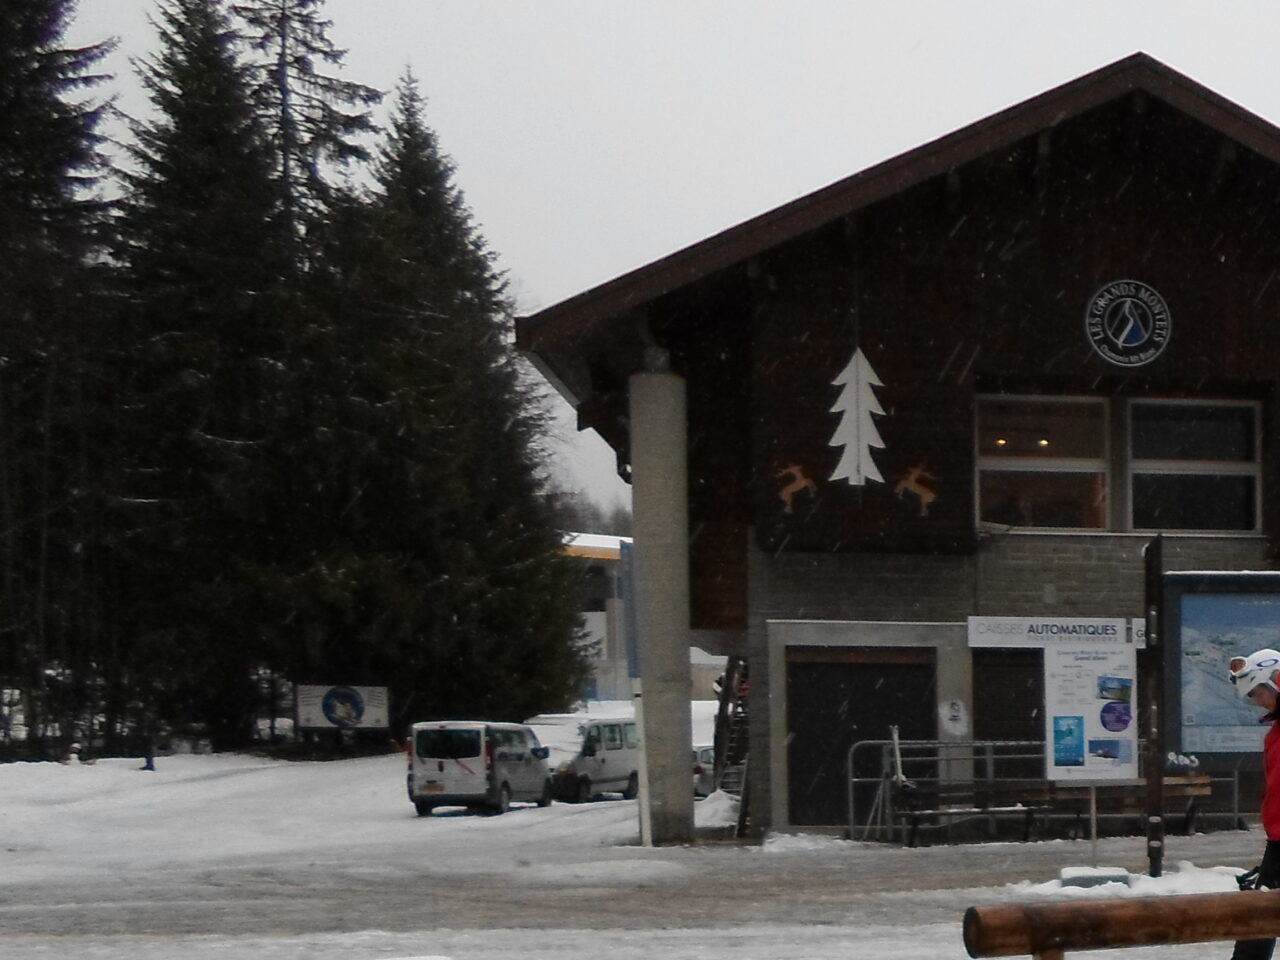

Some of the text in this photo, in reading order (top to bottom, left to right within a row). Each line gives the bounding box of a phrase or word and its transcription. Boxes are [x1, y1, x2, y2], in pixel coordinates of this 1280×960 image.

[1092, 283, 1137, 316] GRANDS
[976, 622, 1117, 636] CAISSES AUTOMATIQUES
